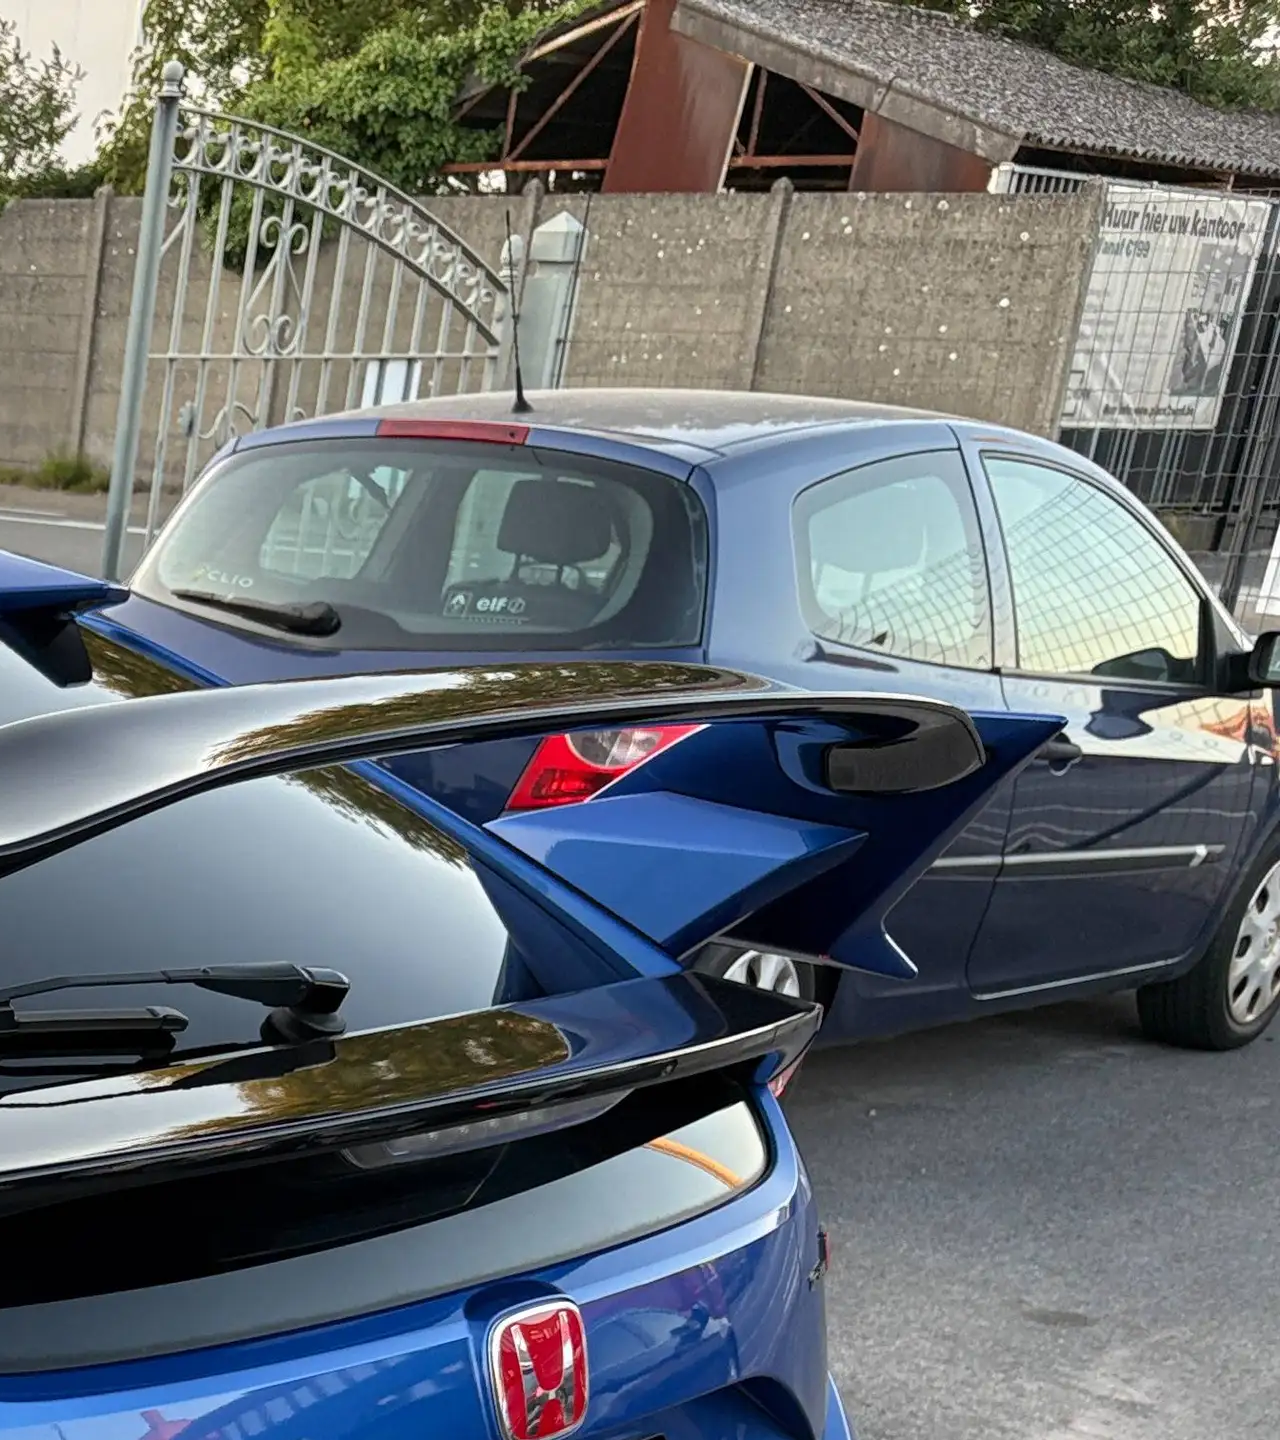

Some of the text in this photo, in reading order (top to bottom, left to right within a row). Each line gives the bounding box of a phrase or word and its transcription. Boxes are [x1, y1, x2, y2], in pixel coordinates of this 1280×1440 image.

[1140, 202, 1169, 233] hier
[1169, 214, 1192, 235] uw
[1190, 209, 1245, 240] kantoor
[207, 570, 254, 588] CLIO
[476, 596, 509, 612] elf
